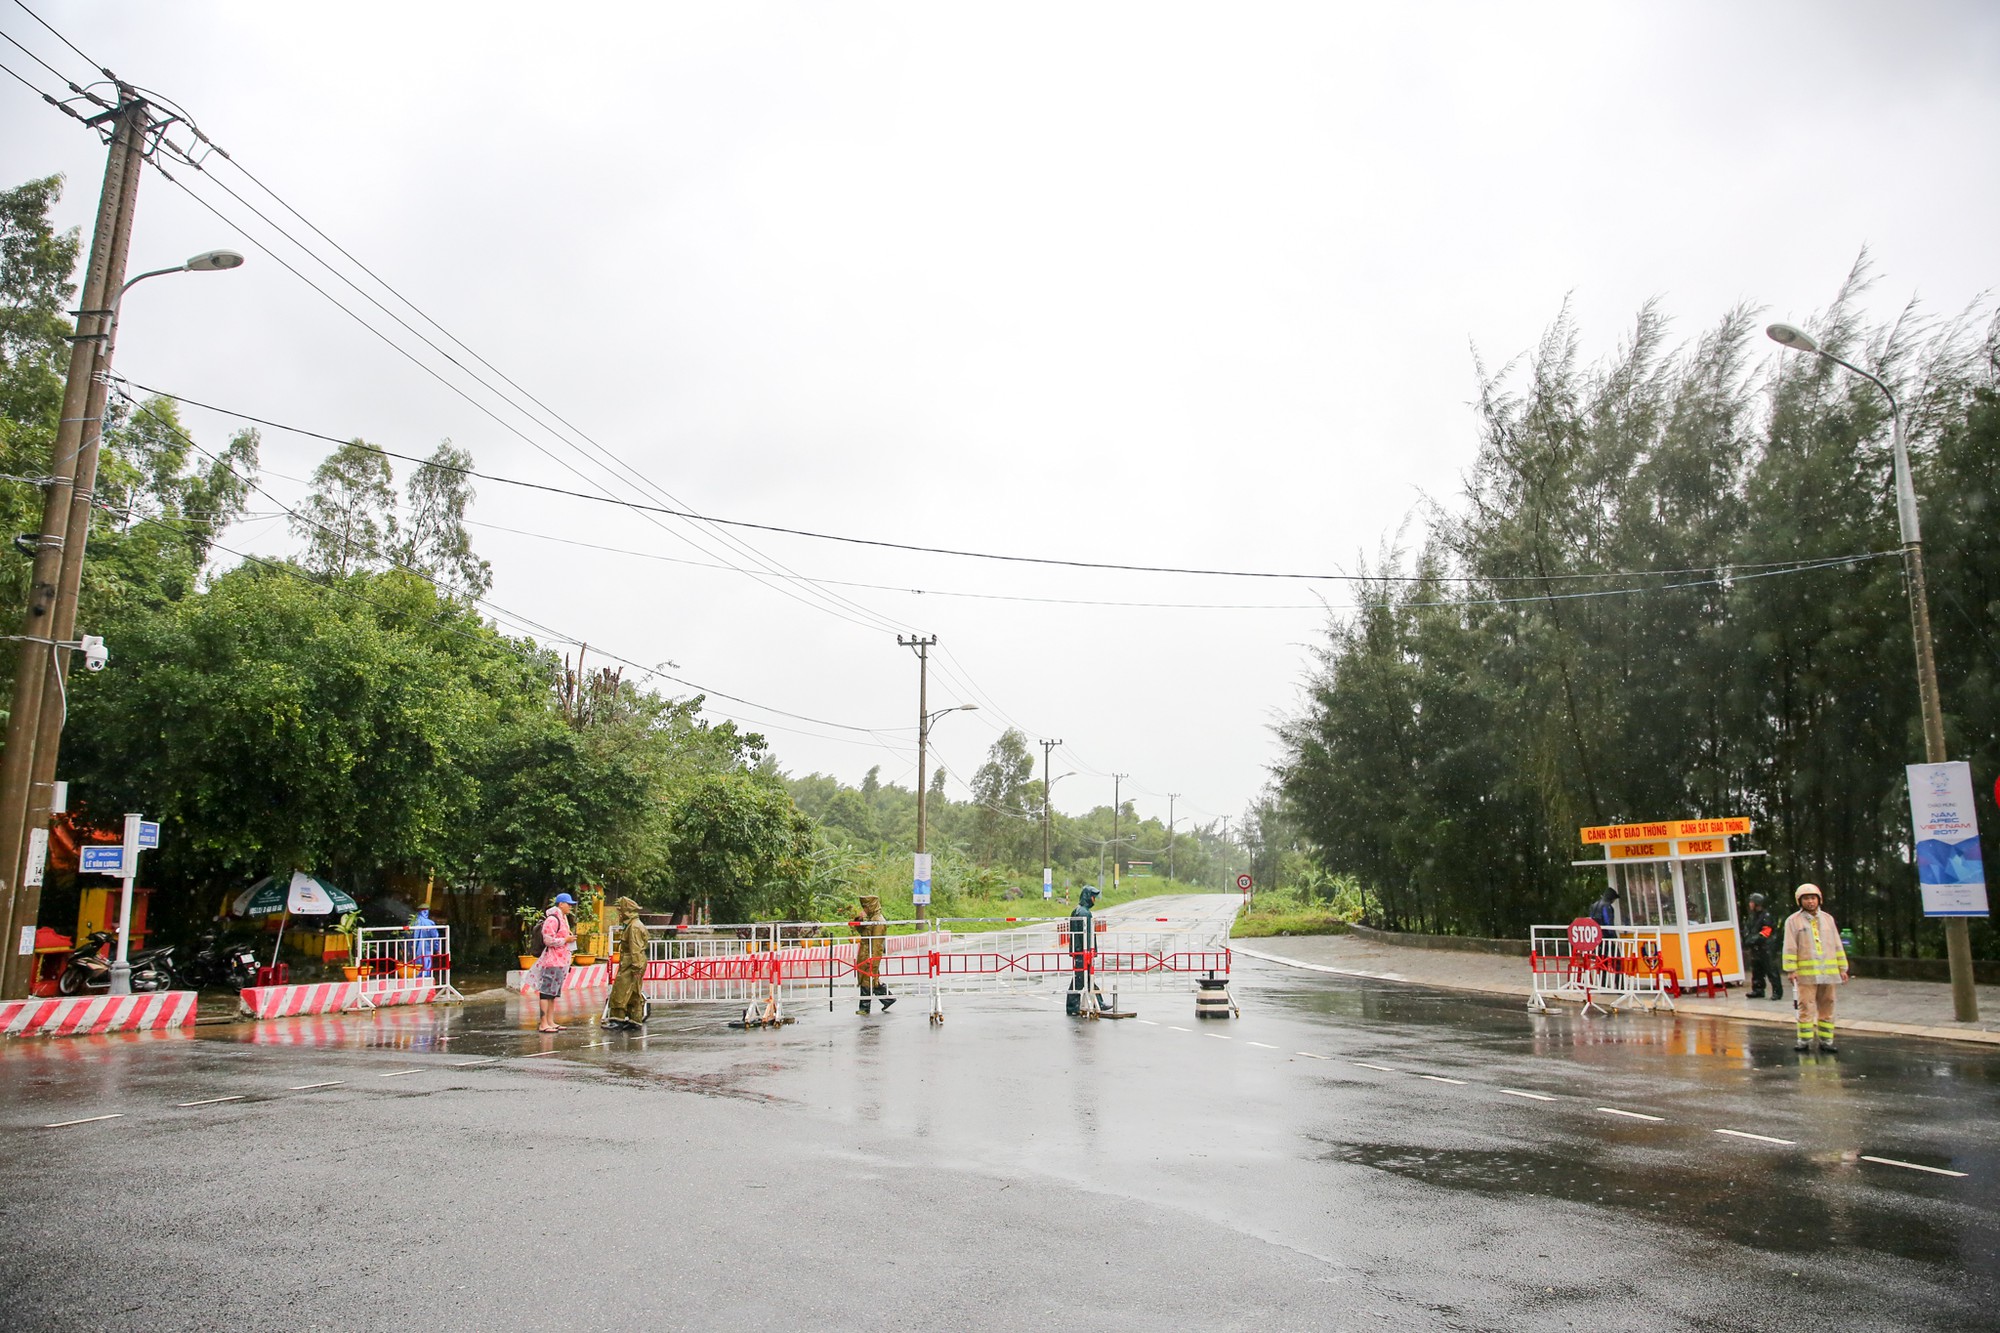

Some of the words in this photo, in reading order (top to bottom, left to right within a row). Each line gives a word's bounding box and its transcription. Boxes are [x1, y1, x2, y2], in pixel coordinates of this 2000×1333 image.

[1587, 828, 1606, 840] CẢNH
[1609, 827, 1621, 839] SÁT
[1624, 827, 1640, 838] GIAO
[1643, 824, 1667, 837] THÔNG
[1681, 821, 1697, 834] CẢNH
[1698, 821, 1709, 833] SÁT
[1711, 821, 1724, 832] GIAO
[1725, 819, 1744, 831] THÔNG
[1625, 844, 1655, 856] POLICE
[1689, 841, 1712, 853] POLICE
[1571, 925, 1599, 943] STOP
